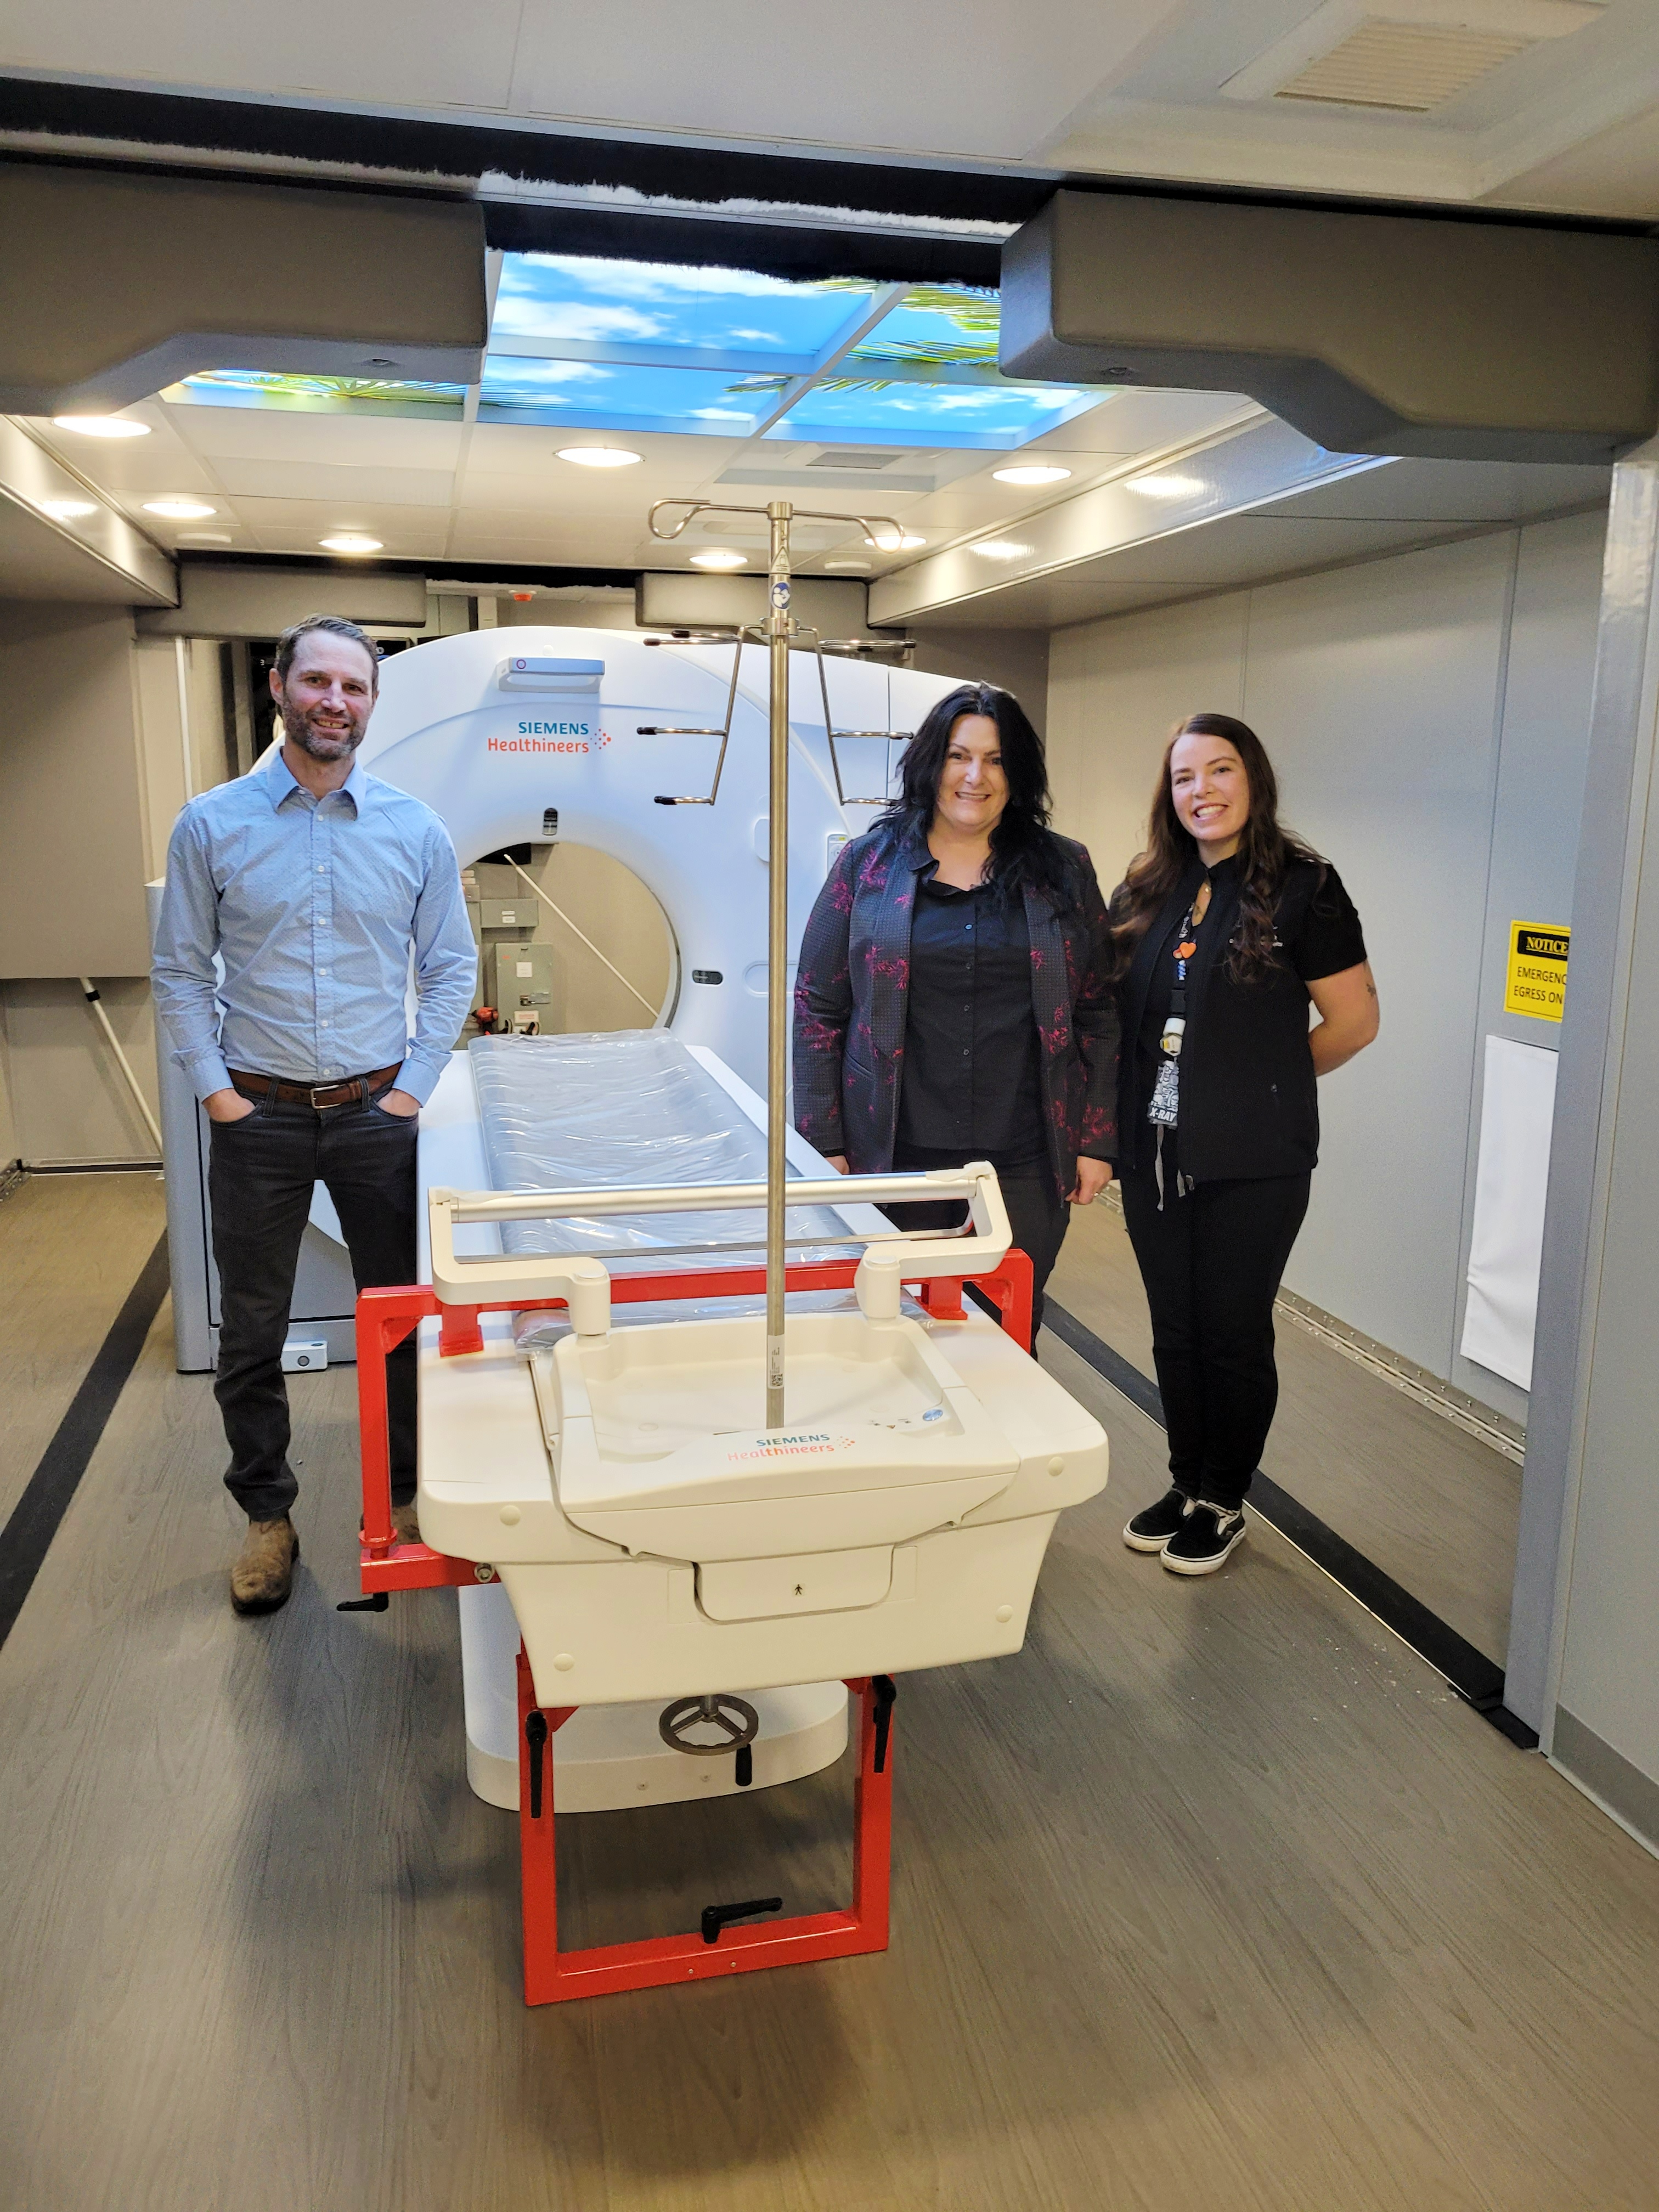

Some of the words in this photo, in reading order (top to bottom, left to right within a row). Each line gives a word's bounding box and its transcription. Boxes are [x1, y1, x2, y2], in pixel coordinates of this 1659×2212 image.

[518, 722, 589, 735] SIEMENS
[488, 737, 589, 753] Healthineers
[1526, 936, 1568, 955] NOTICE
[1514, 985, 1546, 1001] EGRESS
[1549, 992, 1563, 1005] ON
[1149, 1107, 1177, 1122] X-RAY
[756, 1434, 831, 1447] SIEMENS
[727, 1444, 835, 1461] Healthineers
